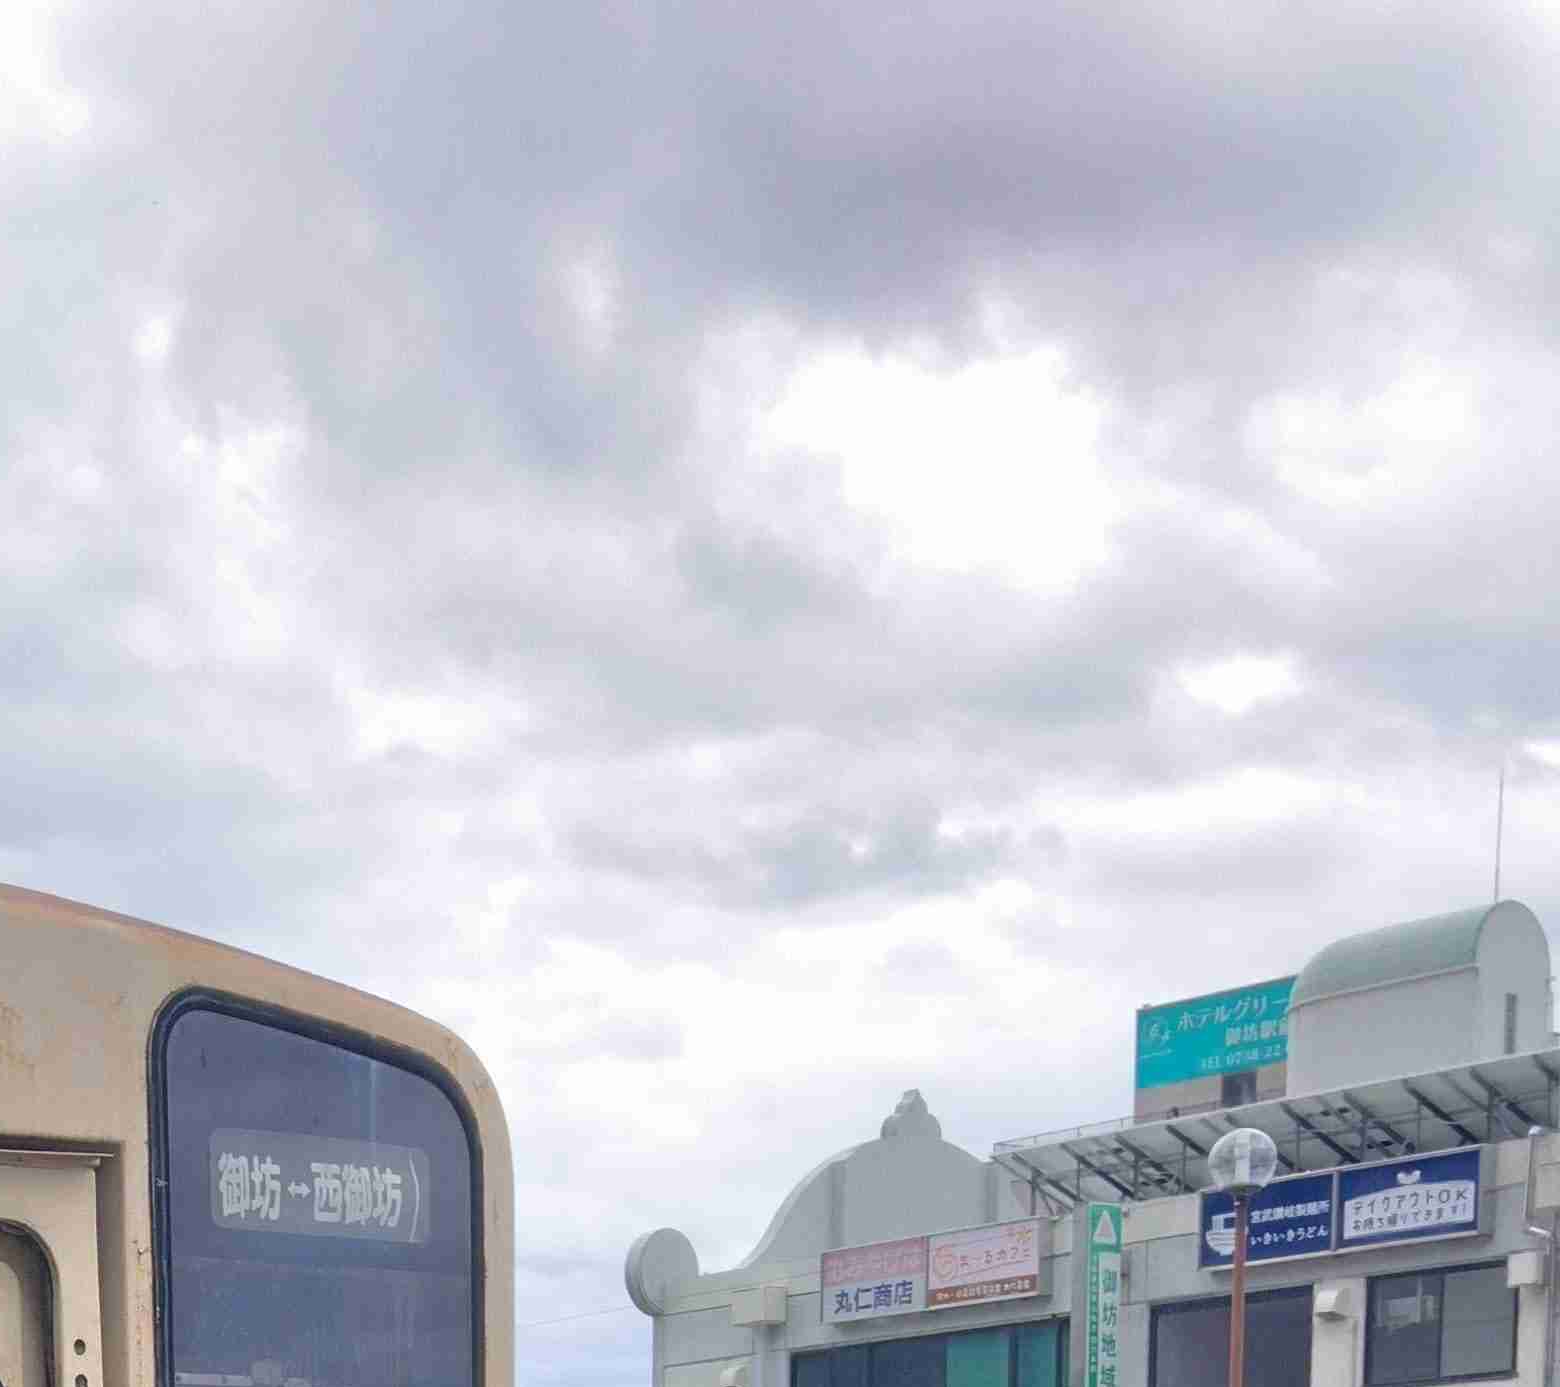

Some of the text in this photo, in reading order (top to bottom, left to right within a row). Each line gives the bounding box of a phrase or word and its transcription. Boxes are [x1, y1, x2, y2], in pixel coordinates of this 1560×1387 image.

[218, 1151, 402, 1228] 御坊 西御坊
[1249, 1224, 1329, 1246] いきいきうどん
[833, 1279, 913, 1315] 丸仁商店
